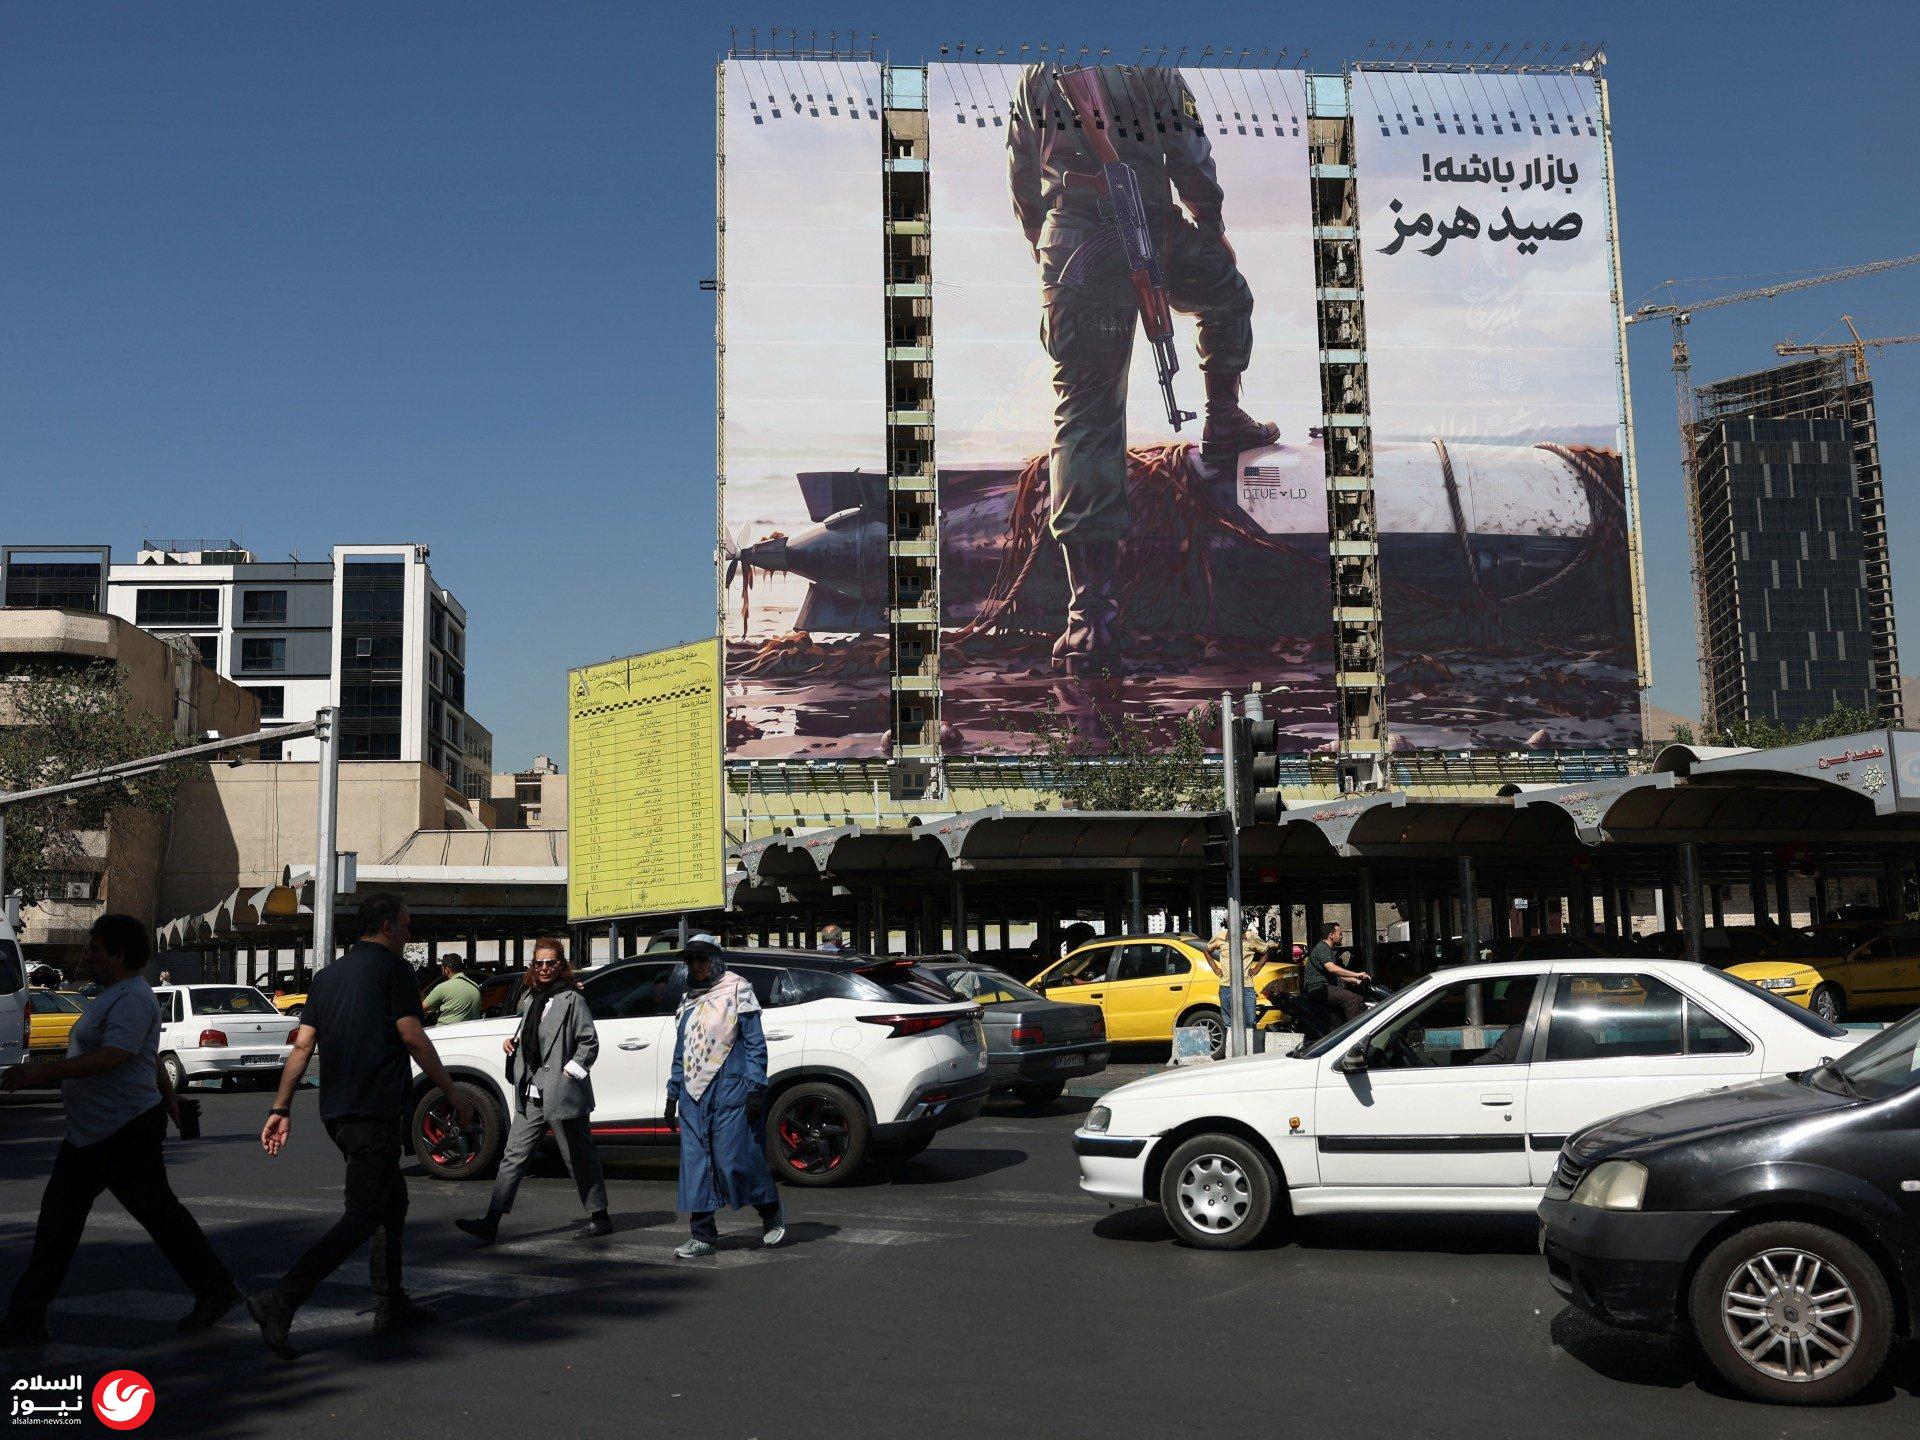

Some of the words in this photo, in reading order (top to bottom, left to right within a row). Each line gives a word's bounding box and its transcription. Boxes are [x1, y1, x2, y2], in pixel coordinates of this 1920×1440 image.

[1422, 153, 1514, 192] باشه!
[1520, 154, 1578, 194] بازار
[1374, 198, 1481, 256] هرمز
[1488, 205, 1583, 256] صید
[1243, 488, 1278, 500] DIVE
[1818, 749, 1850, 769] کرج
[1852, 745, 1884, 762] مقصد
